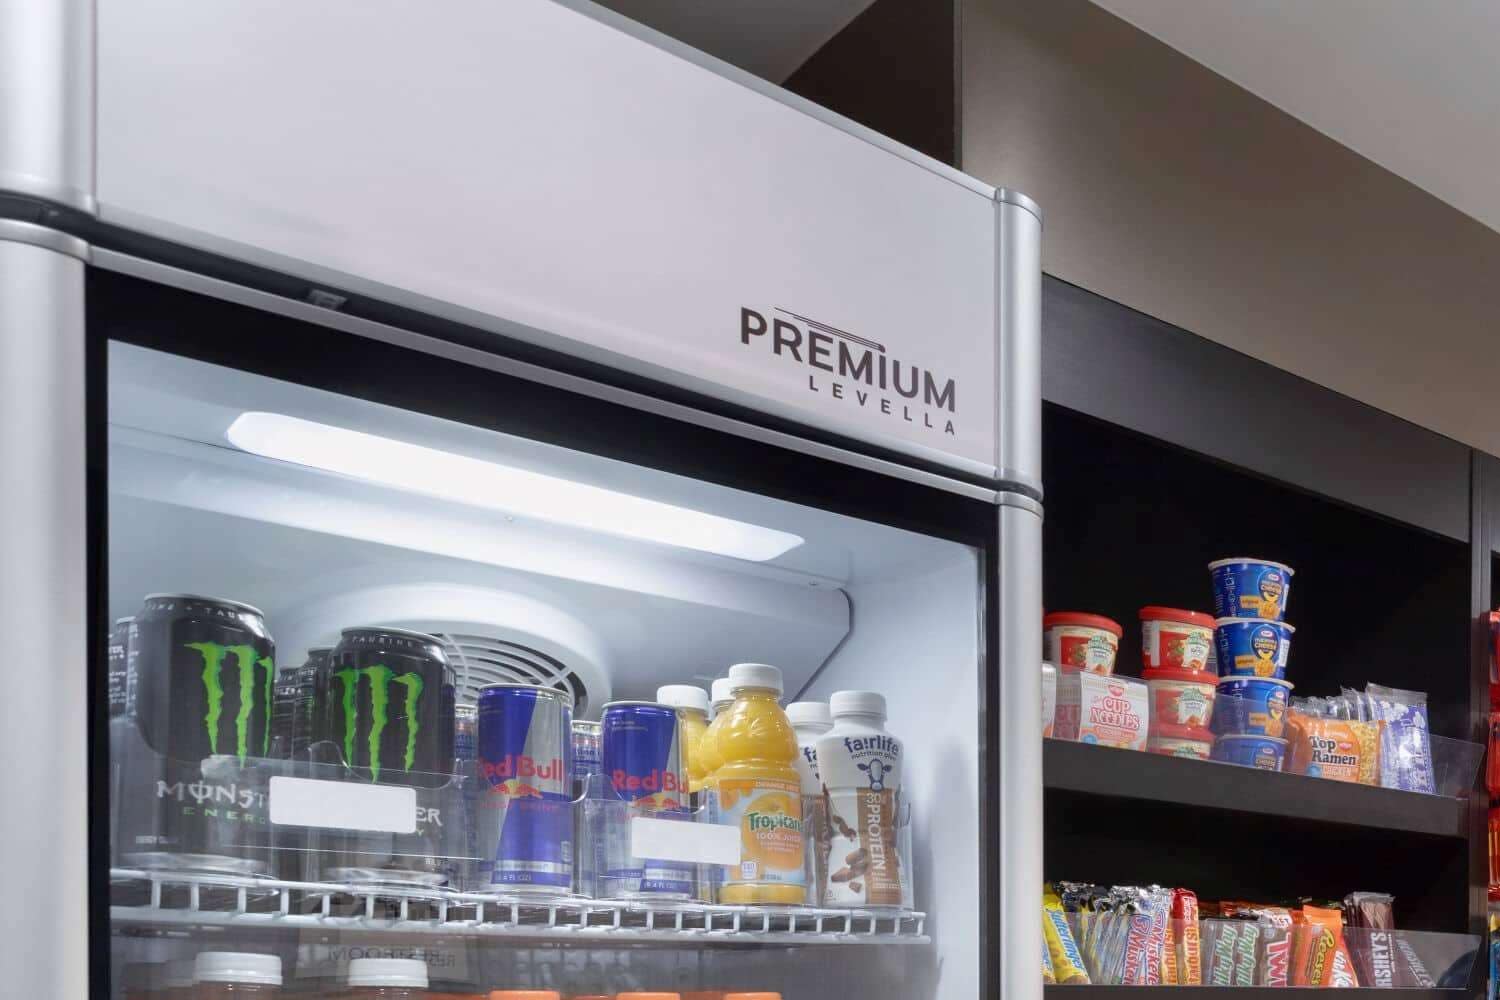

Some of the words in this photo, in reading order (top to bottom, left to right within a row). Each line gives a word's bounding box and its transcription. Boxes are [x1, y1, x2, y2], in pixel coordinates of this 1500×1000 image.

[741, 307, 955, 412] PREMIUM
[809, 375, 955, 435] LEVELLA
[1102, 696, 1131, 712] CUP
[1089, 708, 1140, 730] NOODLES
[1309, 735, 1336, 752] Top
[516, 756, 563, 782] Bull
[1311, 750, 1356, 766] Ramen
[612, 769, 658, 791] Red
[156, 779, 269, 809] MONST
[868, 805, 886, 870] PROTEIN
